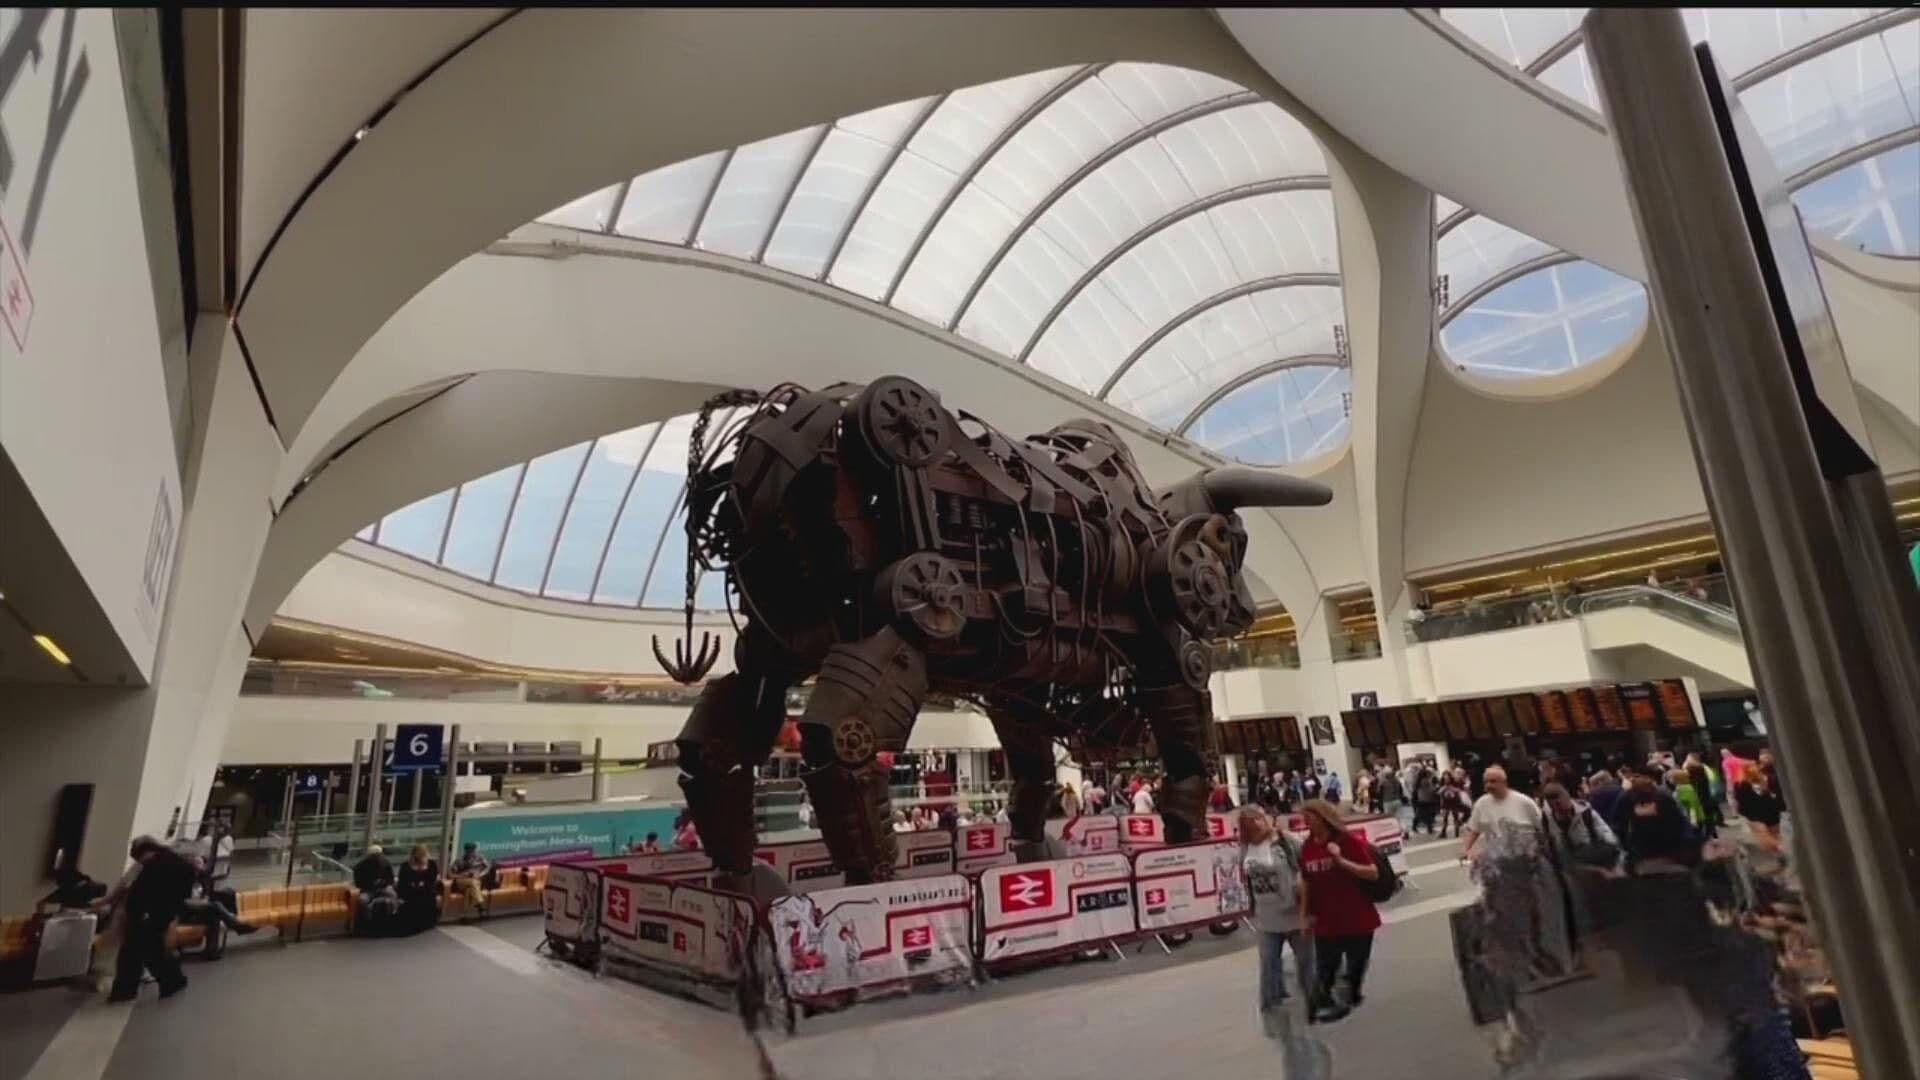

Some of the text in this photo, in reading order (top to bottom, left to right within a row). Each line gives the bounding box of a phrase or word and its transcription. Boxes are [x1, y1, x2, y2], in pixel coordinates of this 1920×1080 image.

[409, 733, 429, 756] 6
[307, 775, 317, 787] 8
[511, 823, 579, 835] Welcome to
[551, 835, 575, 847] New
[578, 834, 610, 845] Street
